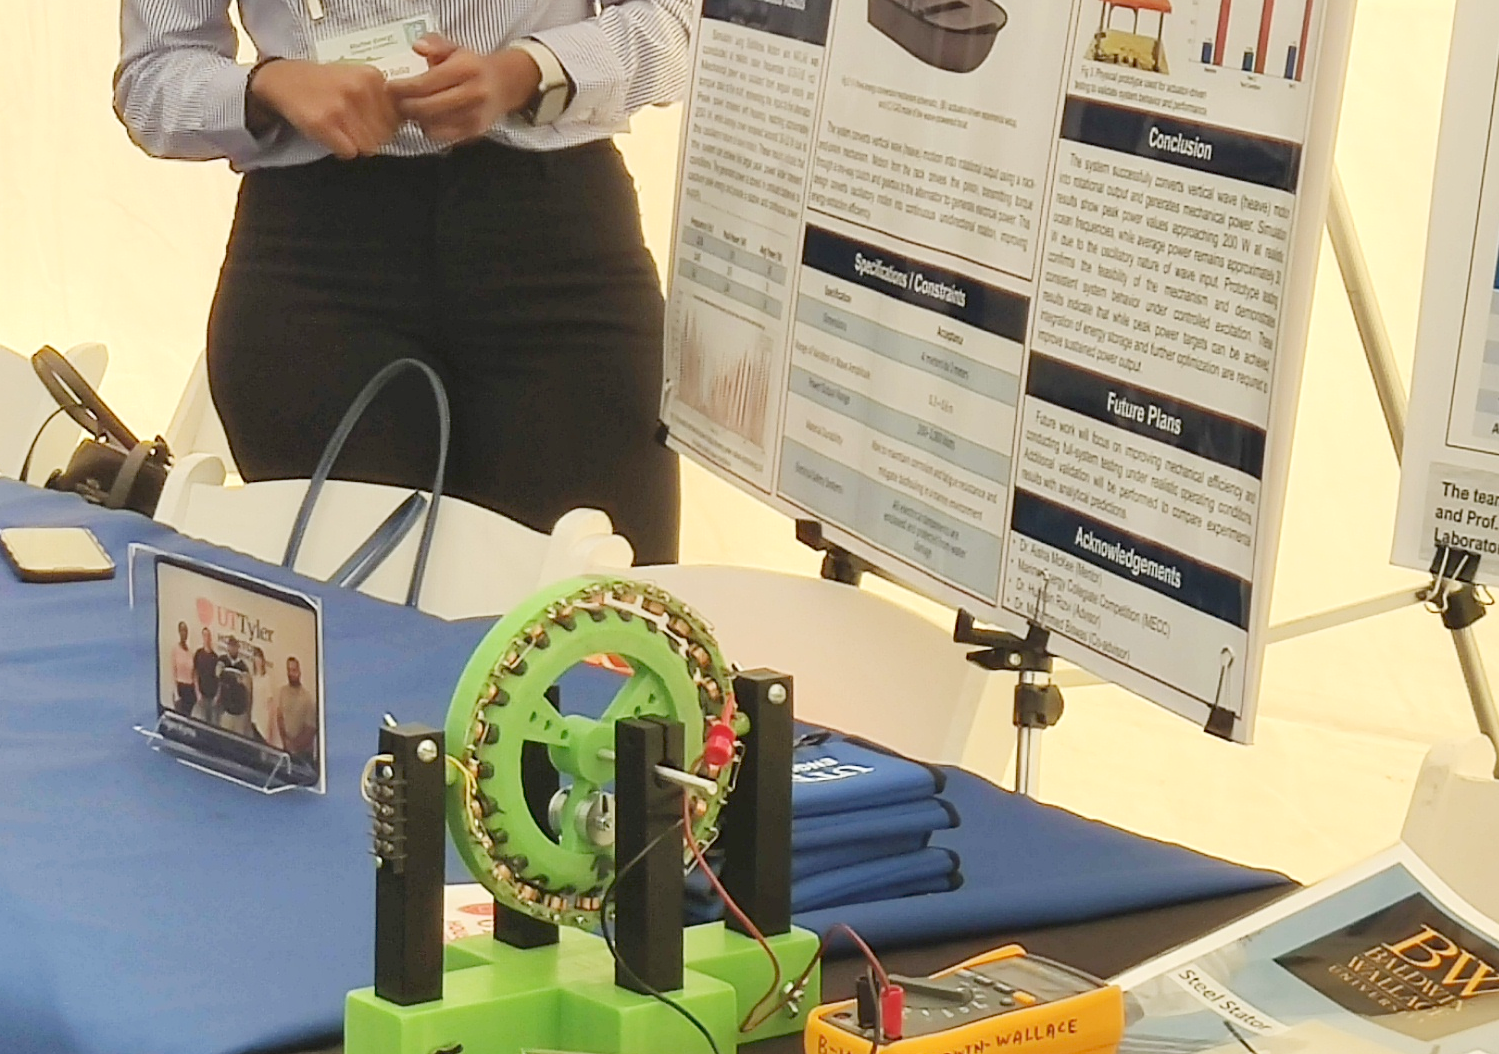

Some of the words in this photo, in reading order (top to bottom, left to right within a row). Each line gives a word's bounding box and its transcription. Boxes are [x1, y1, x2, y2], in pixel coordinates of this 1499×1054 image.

[1149, 126, 1212, 160] Conclusion
[1222, 232, 1238, 250] 200
[854, 252, 907, 288] Specifications
[914, 274, 966, 307] Constraints
[1106, 391, 1145, 423] Future
[1146, 405, 1182, 435] Plans
[1442, 481, 1470, 501] The
[1434, 527, 1499, 555] Laborato
[1435, 507, 1463, 524] and
[1466, 510, 1499, 531] Prof.
[1074, 527, 1182, 589] Acknowledgements
[1100, 594, 1140, 622] Competition
[1141, 612, 1171, 639] (MECC)
[1381, 923, 1499, 1000] BW
[1177, 969, 1219, 1003] Steel
[1219, 1000, 1273, 1033] Stator
